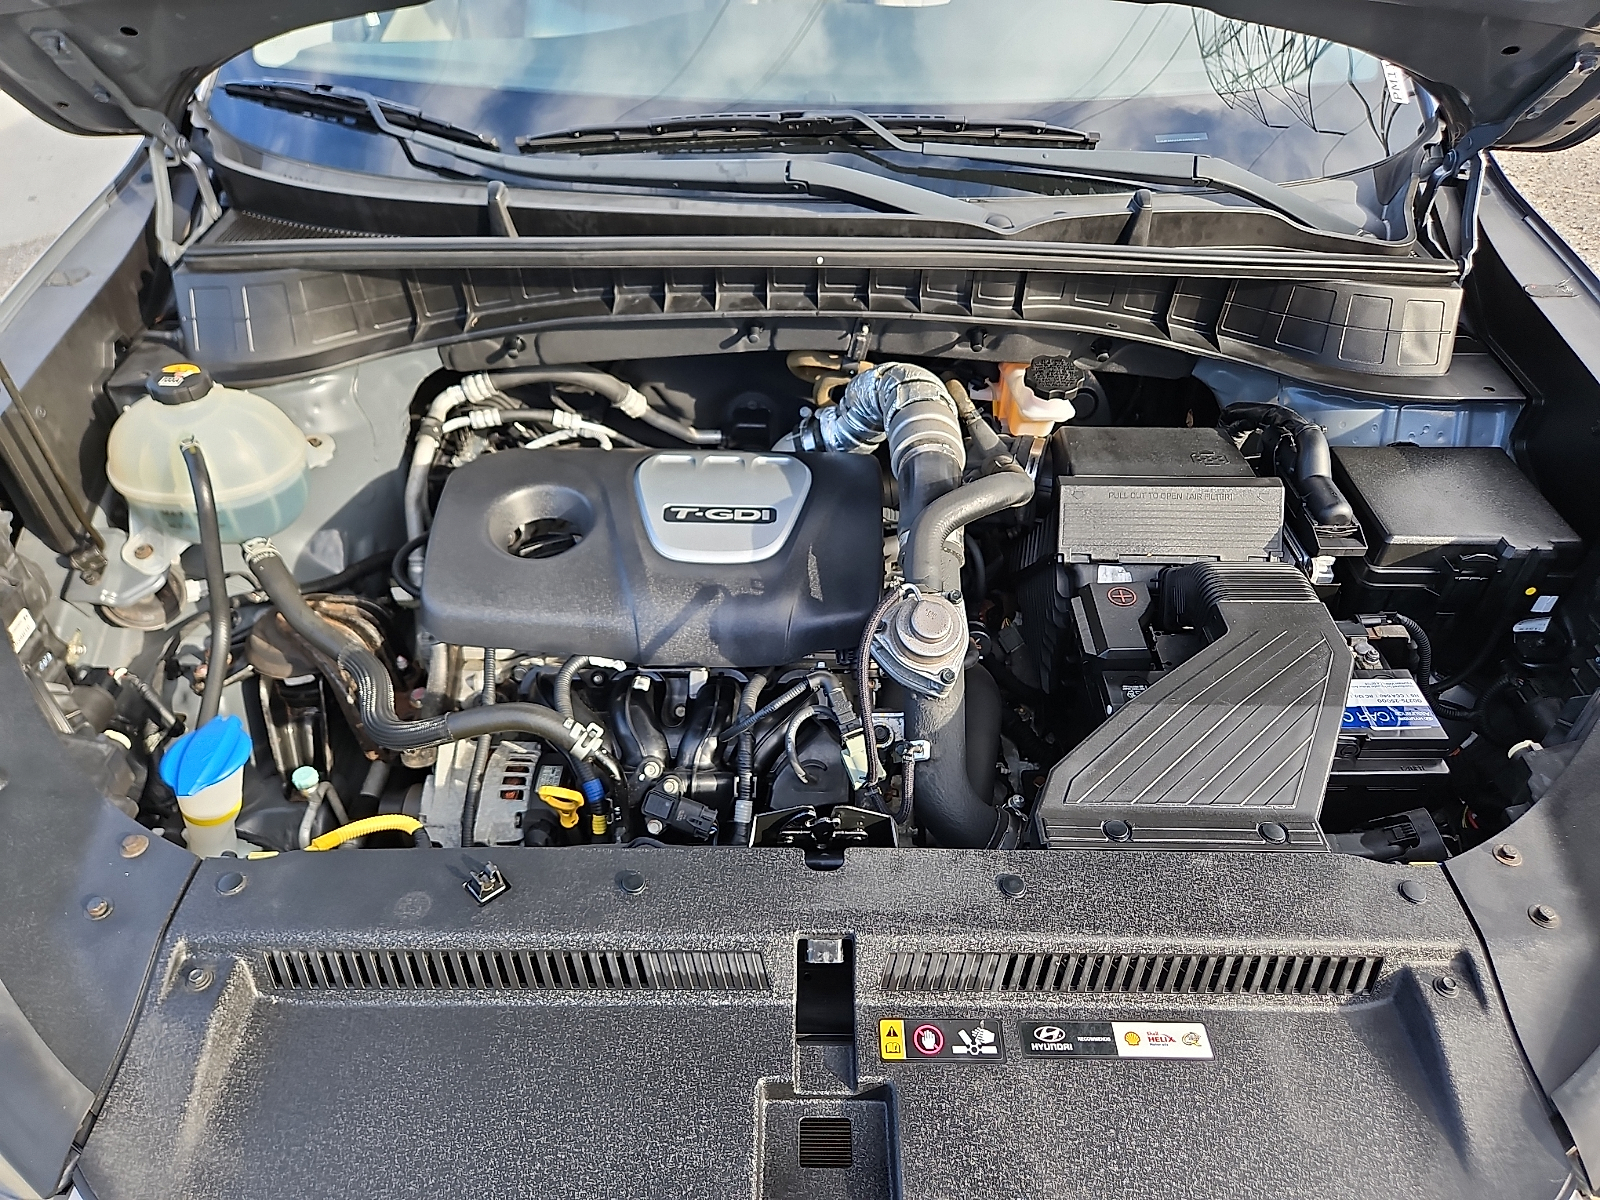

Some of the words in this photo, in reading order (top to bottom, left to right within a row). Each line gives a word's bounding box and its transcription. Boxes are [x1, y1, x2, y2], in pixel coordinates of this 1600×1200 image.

[1108, 491, 1128, 499] PULL
[1160, 492, 1183, 500] OPEN
[1356, 711, 1390, 722] CAR
[1031, 1042, 1074, 1051] HYUNDAI
